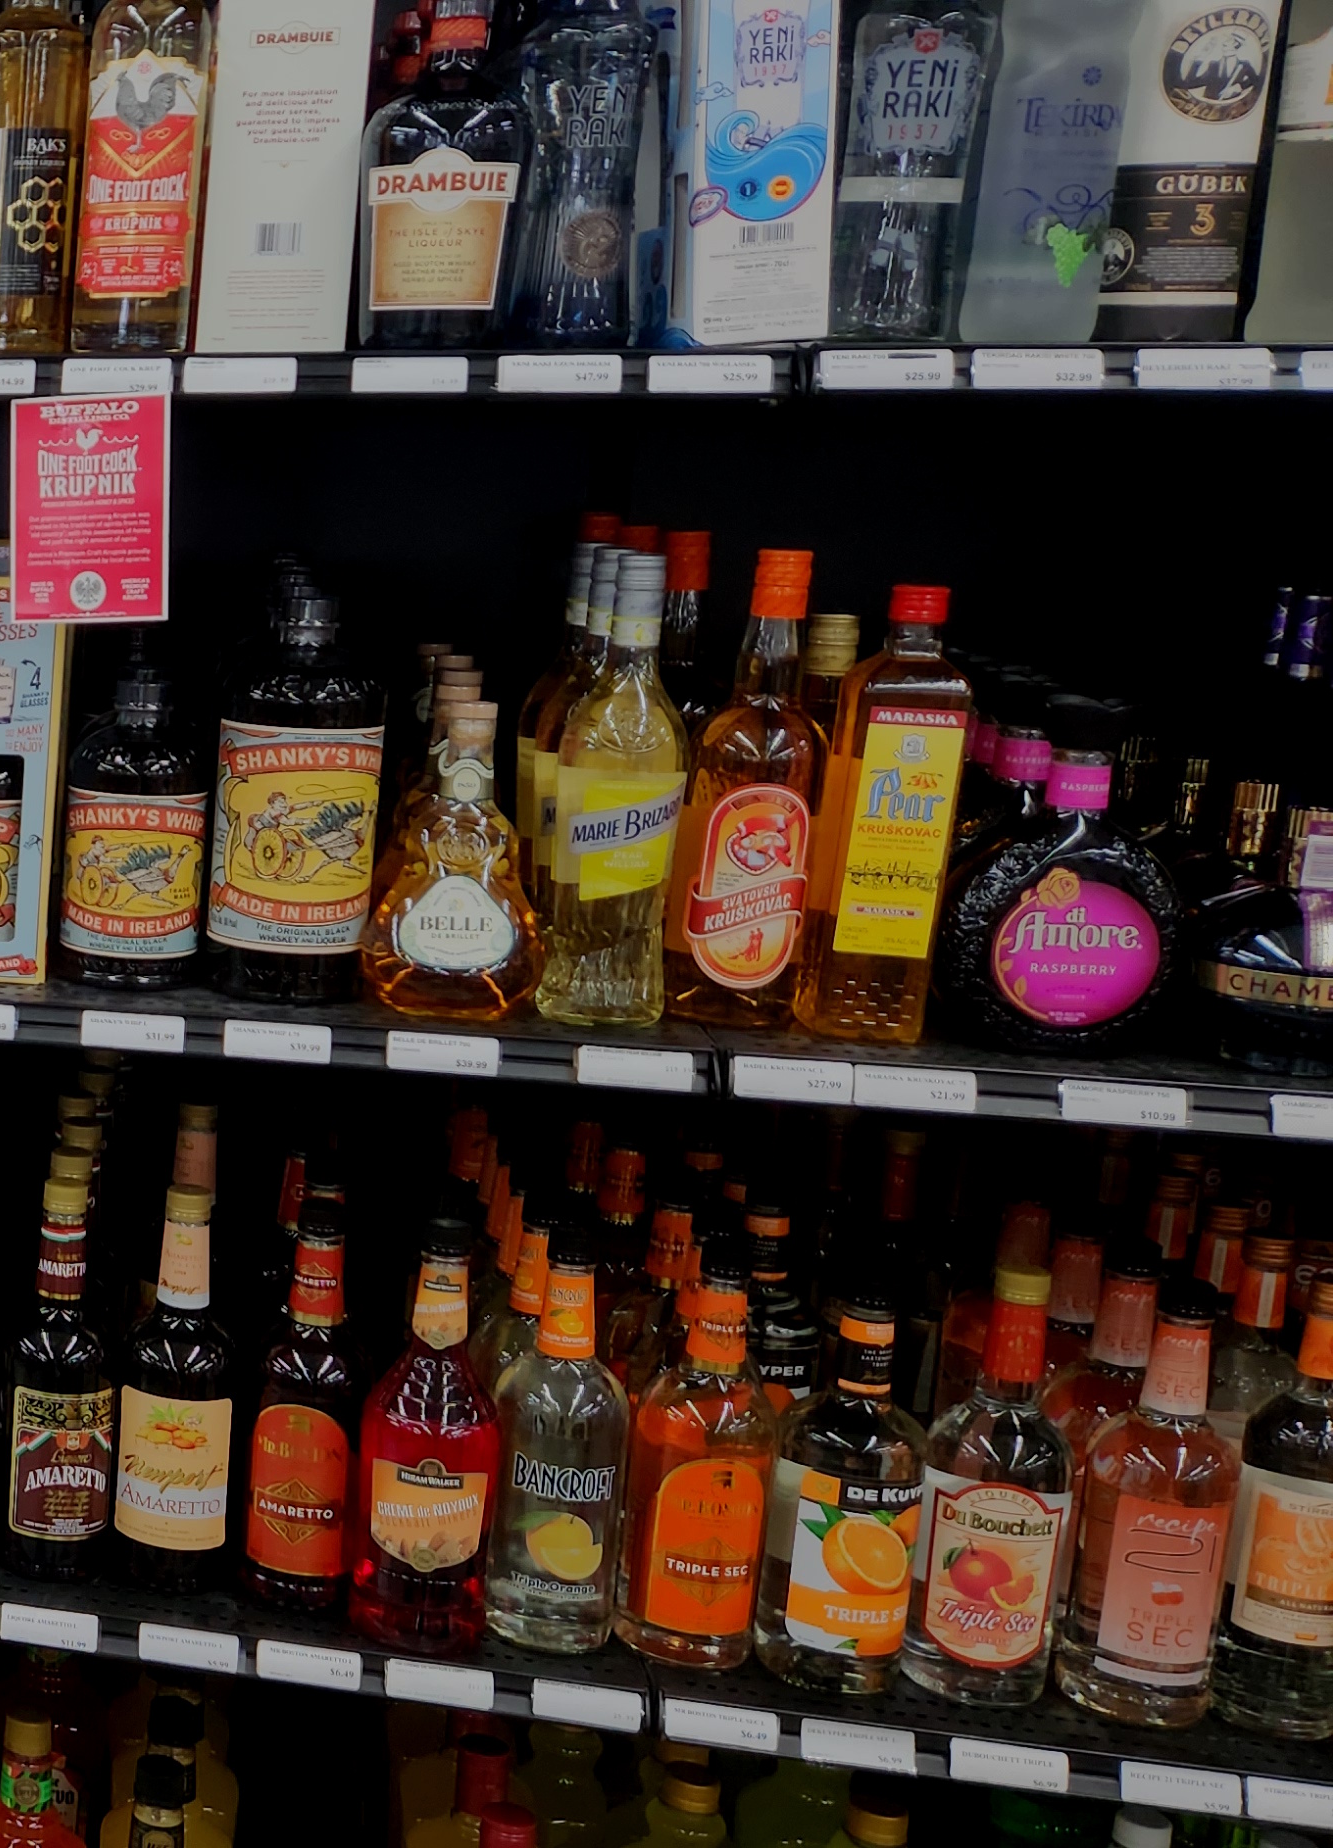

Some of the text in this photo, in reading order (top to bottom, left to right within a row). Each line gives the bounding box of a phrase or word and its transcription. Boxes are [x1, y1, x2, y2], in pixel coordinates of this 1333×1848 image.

[256, 30, 333, 44] DRAMBUIE
[750, 43, 795, 64] RAKI
[754, 64, 788, 77] 1937
[264, 100, 305, 108] delicious
[285, 89, 338, 99] inspiration
[288, 108, 321, 116] serves,
[883, 90, 952, 119] RAKI
[237, 118, 289, 127] guaranteed
[305, 117, 340, 125] impress
[272, 128, 304, 136] guests,
[886, 124, 939, 141] 1937
[89, 173, 186, 204] ONE FOOT COCK
[378, 172, 507, 195] DRAMBUIE
[1156, 174, 1248, 194] GÖBEK
[105, 216, 162, 231] KRUPNIK
[1190, 204, 1216, 236] 3
[388, 228, 408, 237] THE
[412, 228, 439, 237] ISLE
[456, 227, 485, 236] SKYE
[575, 372, 609, 382] $47.99
[723, 372, 758, 382] $25.99
[905, 372, 941, 381] $25.99
[1055, 372, 1092, 382] $32.99
[40, 401, 139, 419] BUFFALO
[38, 445, 139, 476] ONE FOOT COCK
[40, 473, 136, 498] KRUPNIK
[877, 709, 959, 725] MARASKA
[236, 747, 349, 768] SHANKY'S
[862, 766, 946, 824] Pear
[69, 808, 204, 829] SHANKY'S WHIP
[572, 798, 681, 844] MARIE BRIZARD
[857, 821, 942, 839] KRUŠKOVAC
[722, 884, 780, 909] SVATOVSKI
[68, 906, 191, 934] MADE IN IRELAND
[419, 916, 493, 931] BELLE
[1066, 907, 1086, 925] di
[1010, 910, 1138, 953] Amore
[1030, 962, 1117, 976] RASPBERRY
[807, 1078, 841, 1090] $27.99
[1141, 1110, 1176, 1122] $10.99
[23, 1466, 107, 1493] AMARETTO
[513, 1451, 617, 1503] BANCROFT
[120, 1482, 220, 1516] AMARETTO
[258, 1498, 333, 1520] AMARETTO
[943, 1504, 1053, 1538] Du Bouchett
[666, 1557, 749, 1577] TRIPLE SEC
[939, 1600, 1036, 1635] Triple Sec
[1130, 1607, 1195, 1627] TRIPLE
[1125, 1621, 1194, 1649] SEC
